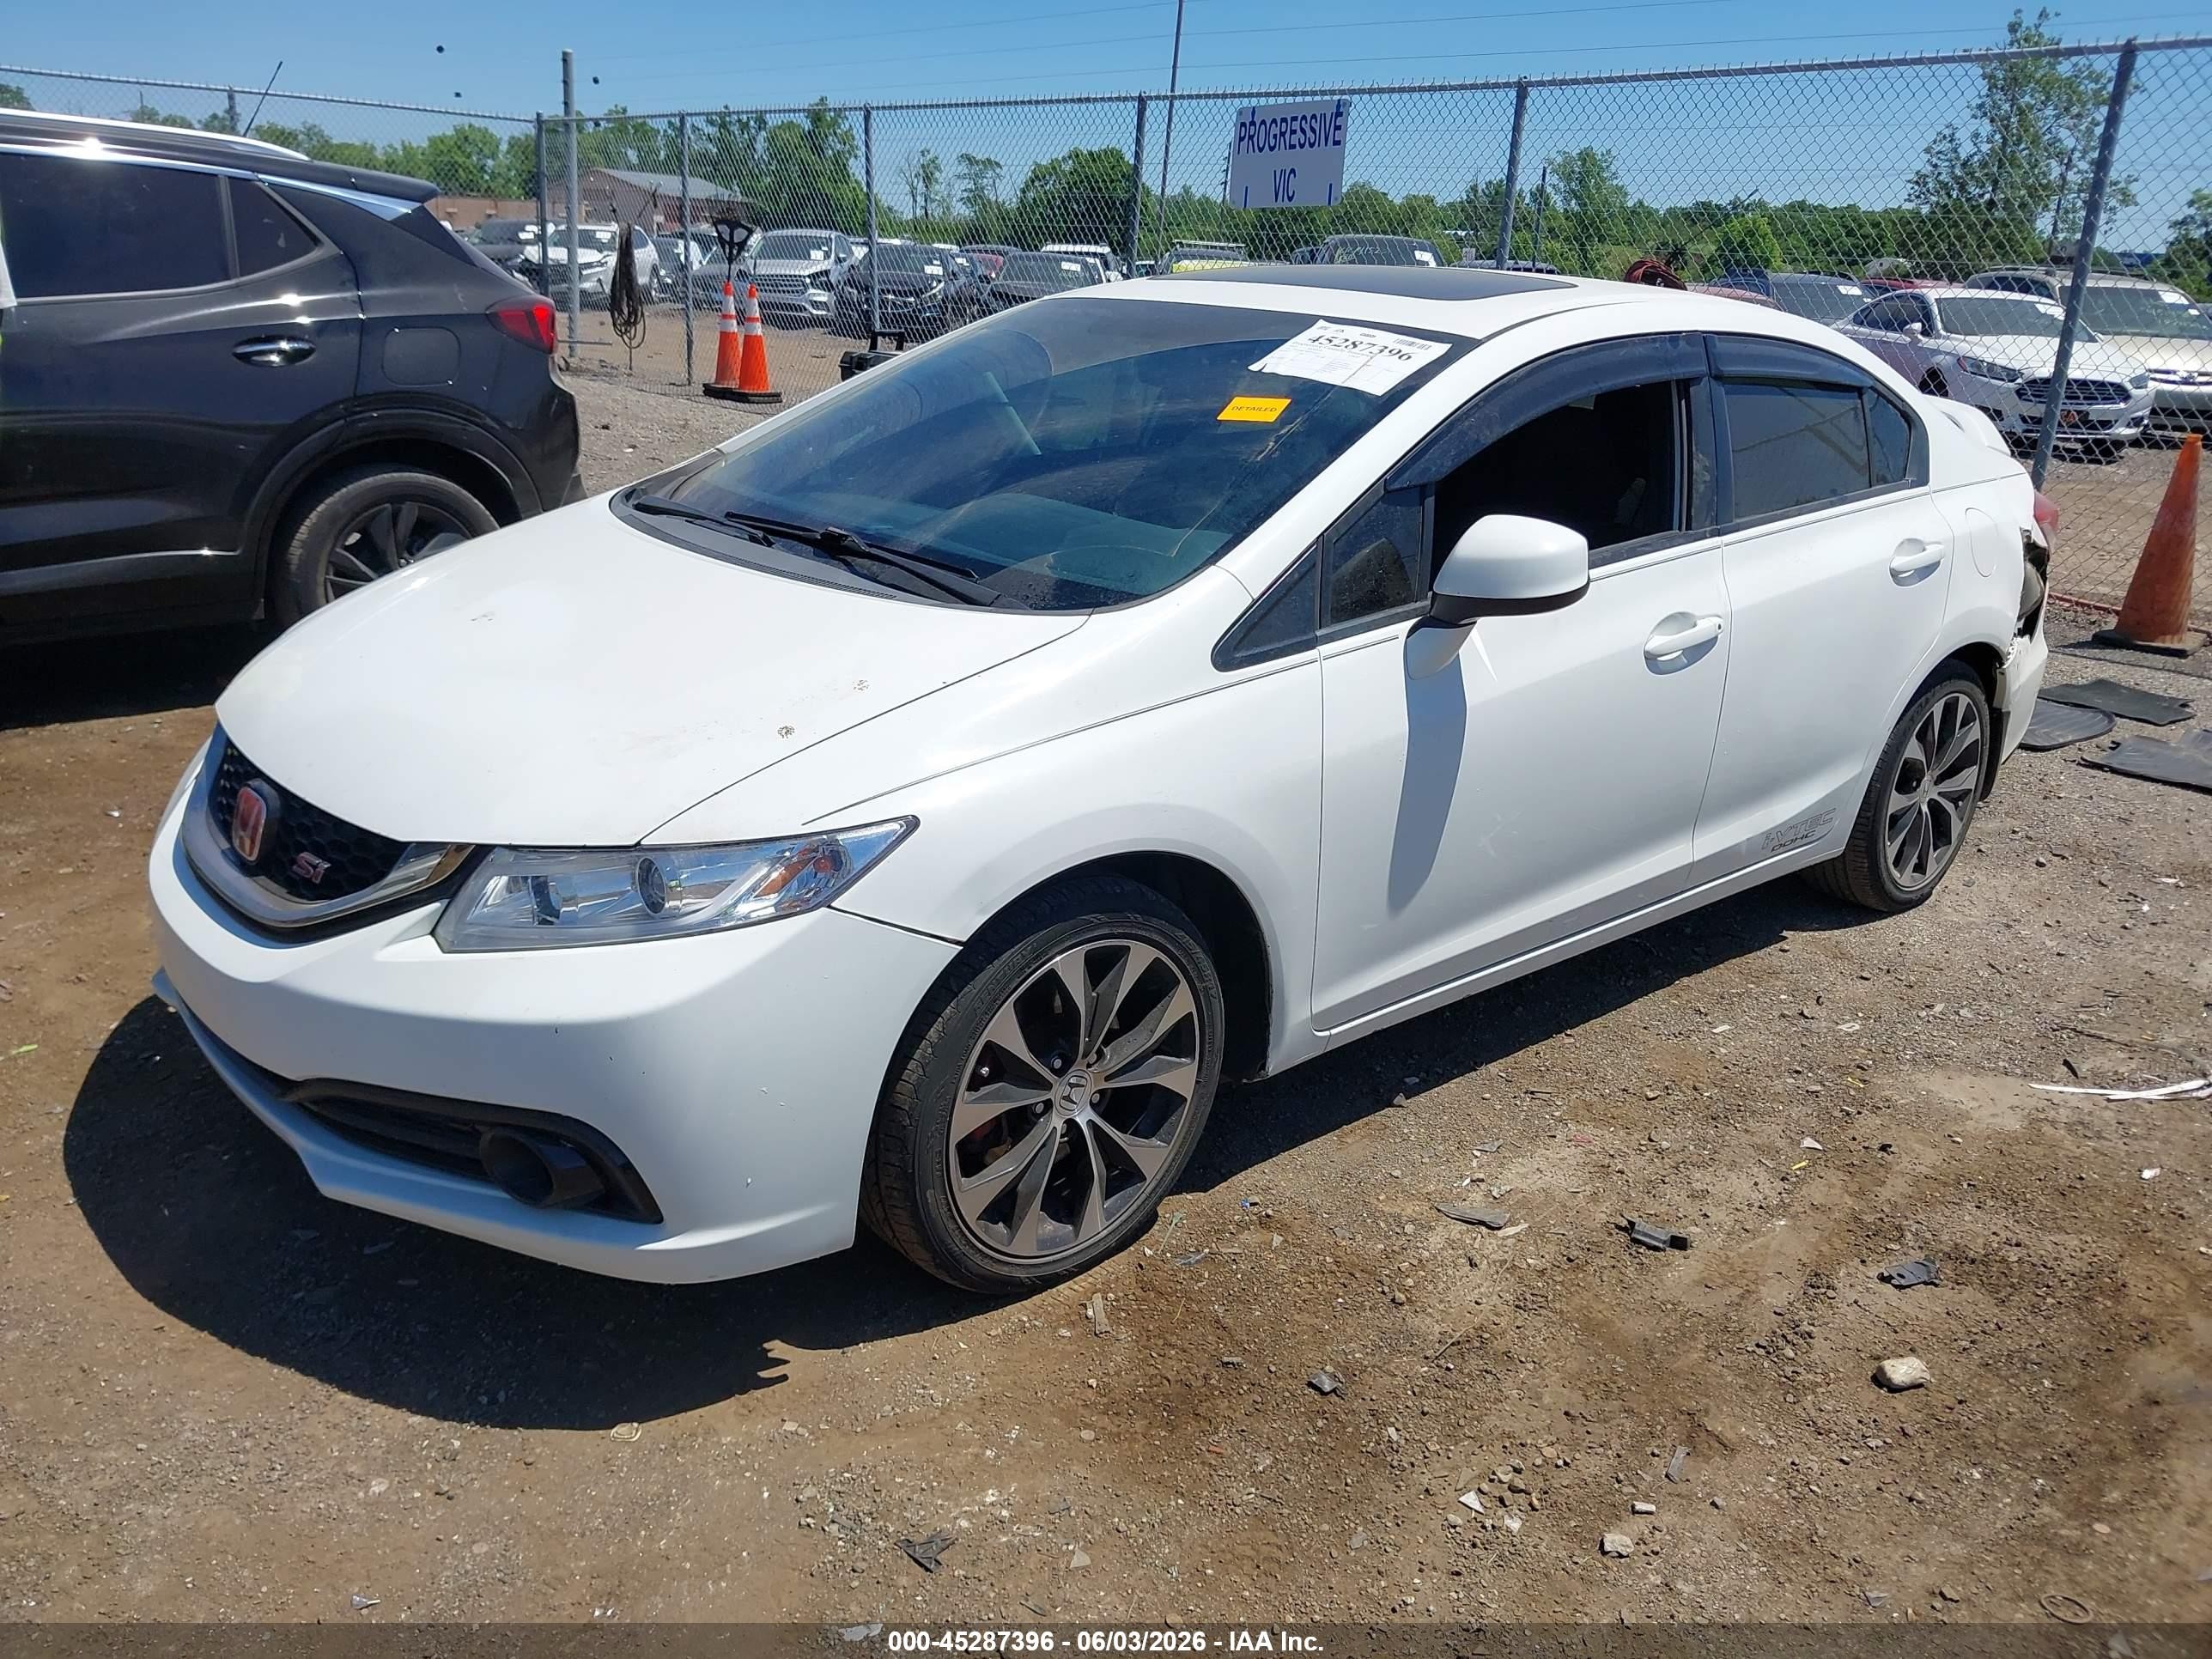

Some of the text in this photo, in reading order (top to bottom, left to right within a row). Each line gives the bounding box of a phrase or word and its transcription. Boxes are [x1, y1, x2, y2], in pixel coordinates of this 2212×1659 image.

[1237, 111, 1344, 155] PROGRESSIVE
[1273, 167, 1297, 203] VIC
[1308, 334, 1413, 362] 45287396
[1771, 830, 1816, 853] DOHC
